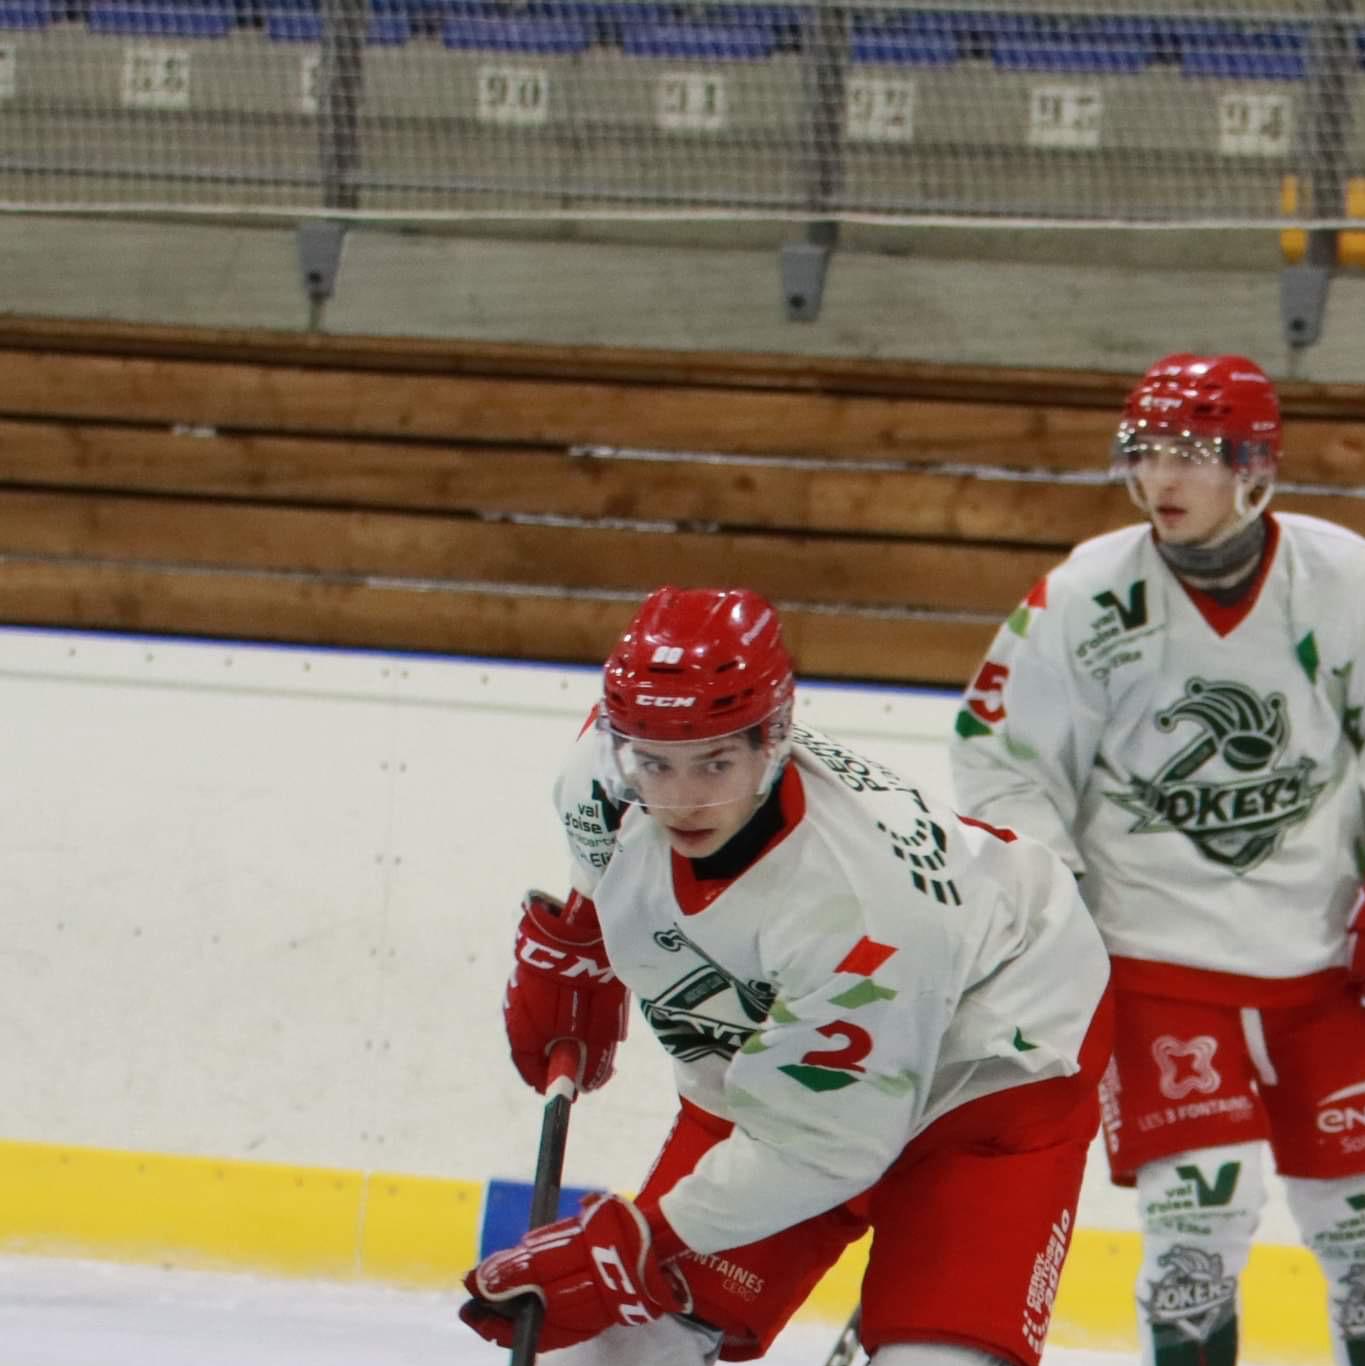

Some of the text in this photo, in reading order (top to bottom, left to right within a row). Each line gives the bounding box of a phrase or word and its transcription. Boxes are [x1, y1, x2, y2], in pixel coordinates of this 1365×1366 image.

[635, 694, 697, 708] CCM
[966, 661, 1009, 722] 5
[801, 1019, 874, 1074] 2
